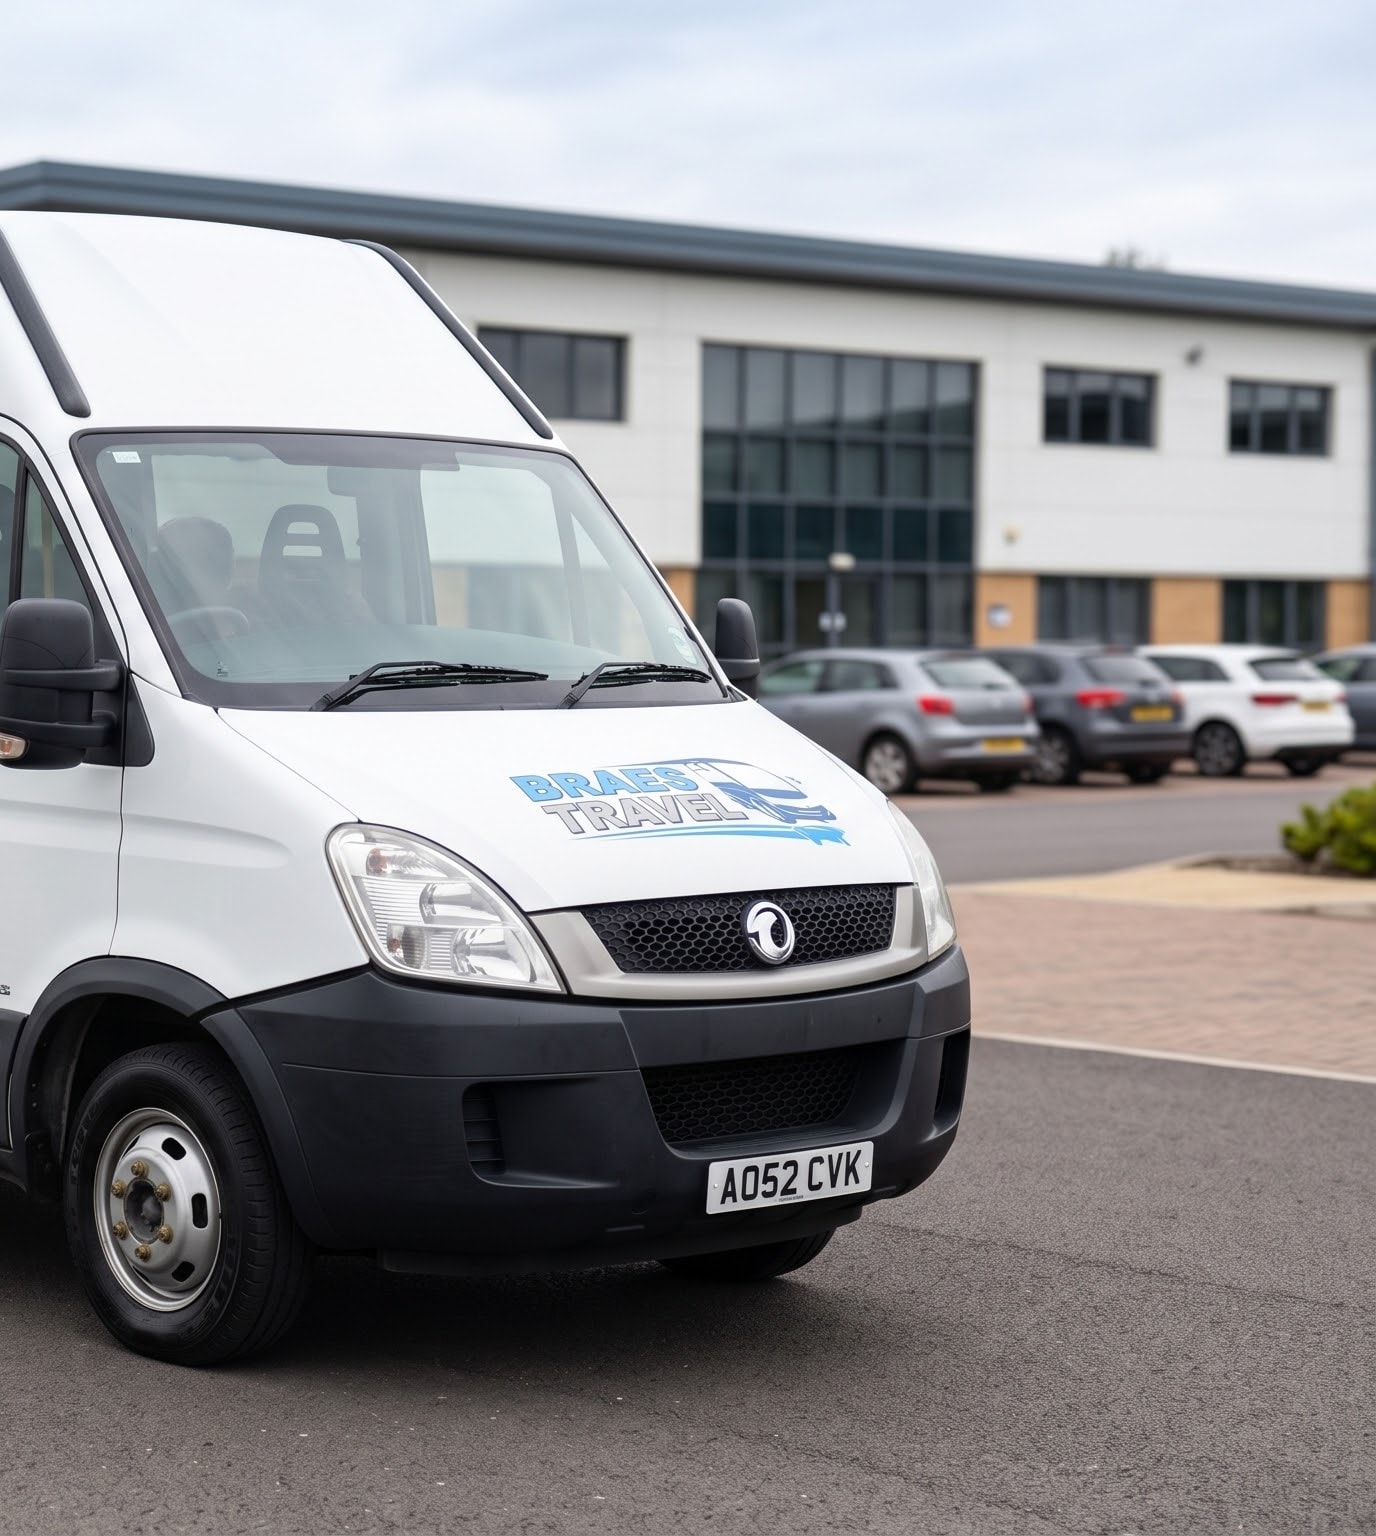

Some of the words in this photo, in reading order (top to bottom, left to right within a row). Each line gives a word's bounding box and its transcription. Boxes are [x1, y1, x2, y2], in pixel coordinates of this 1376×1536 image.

[510, 767, 699, 802] BRAES
[542, 793, 749, 834] TRAVEL
[808, 1150, 862, 1192] CVK
